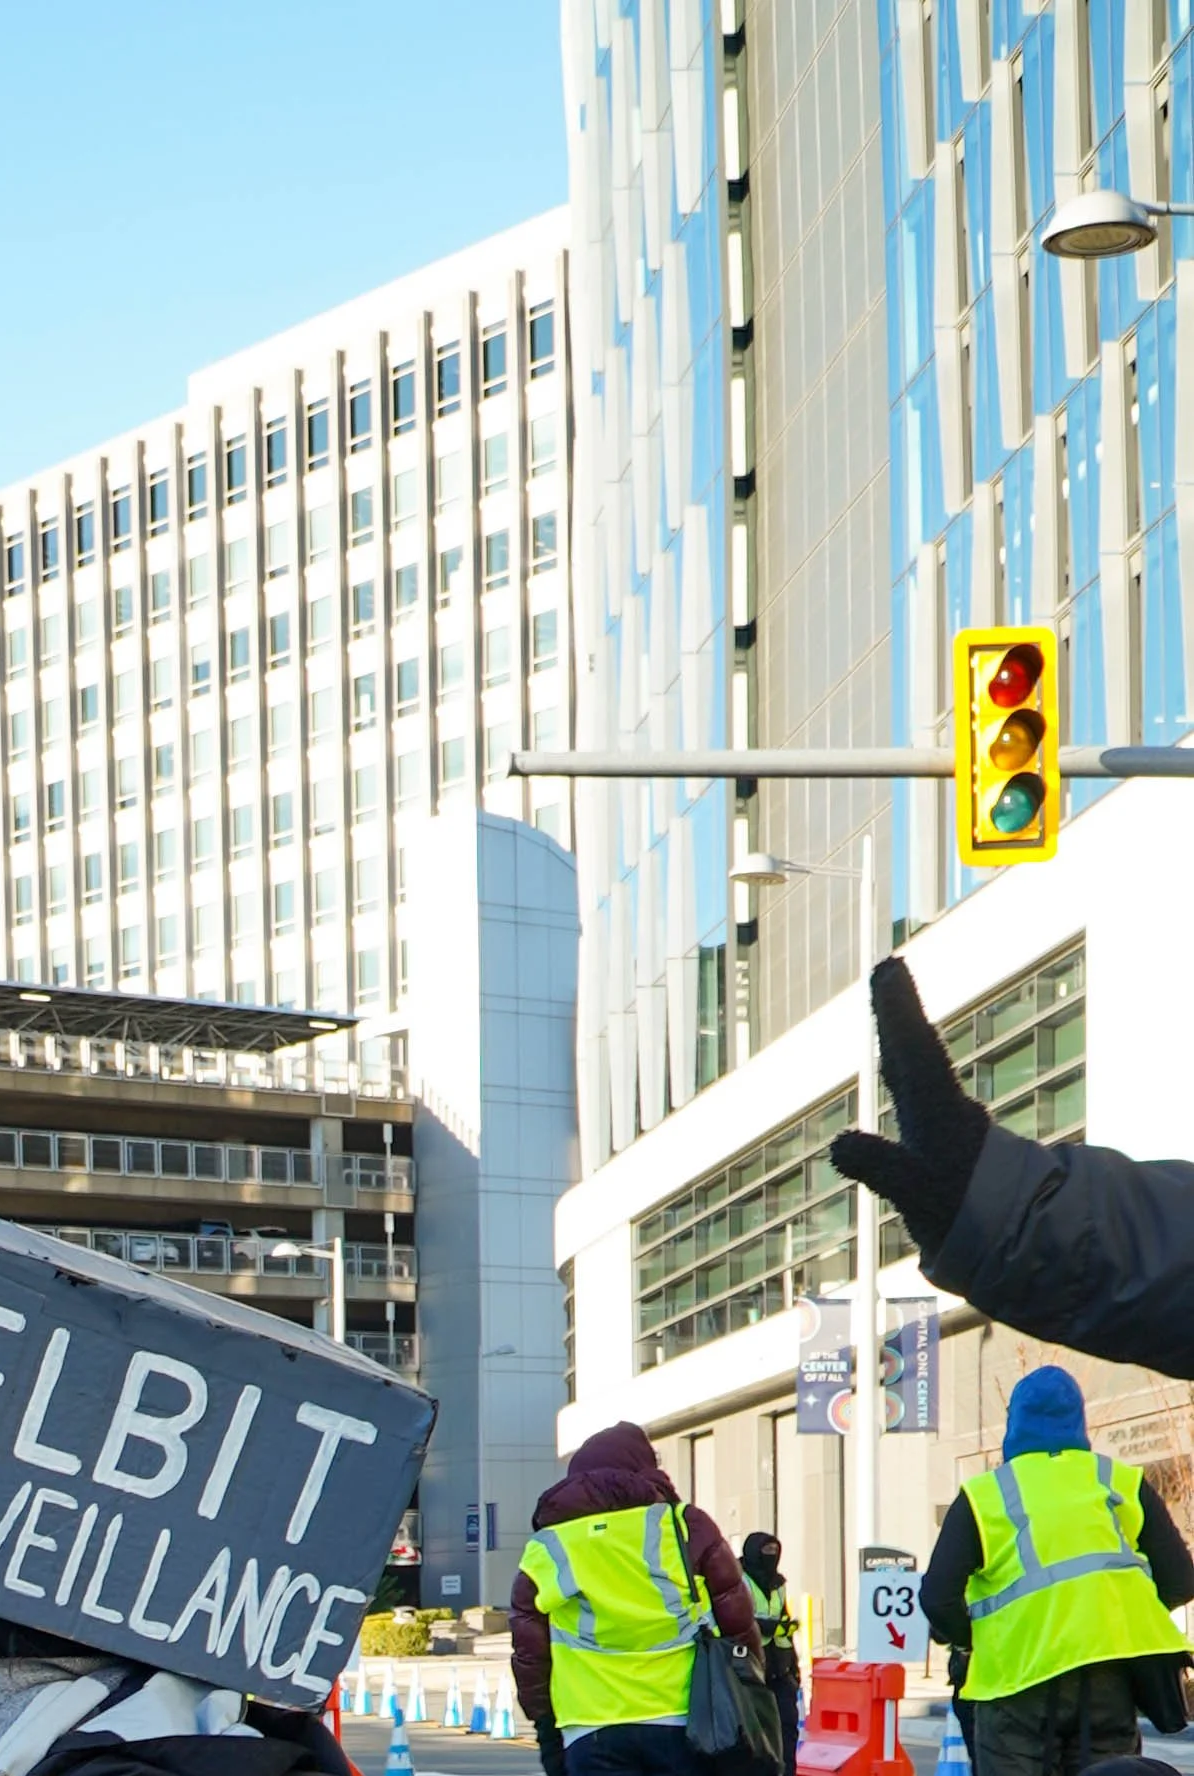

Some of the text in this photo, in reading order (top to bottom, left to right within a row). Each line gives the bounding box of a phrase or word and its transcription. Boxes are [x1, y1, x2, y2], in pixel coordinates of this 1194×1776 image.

[800, 1360, 848, 1373] CENTER
[917, 1301, 929, 1428] CAPITAL ONE CENTER
[804, 1373, 844, 1383] OF IT ALL
[872, 1585, 915, 1617] C3
